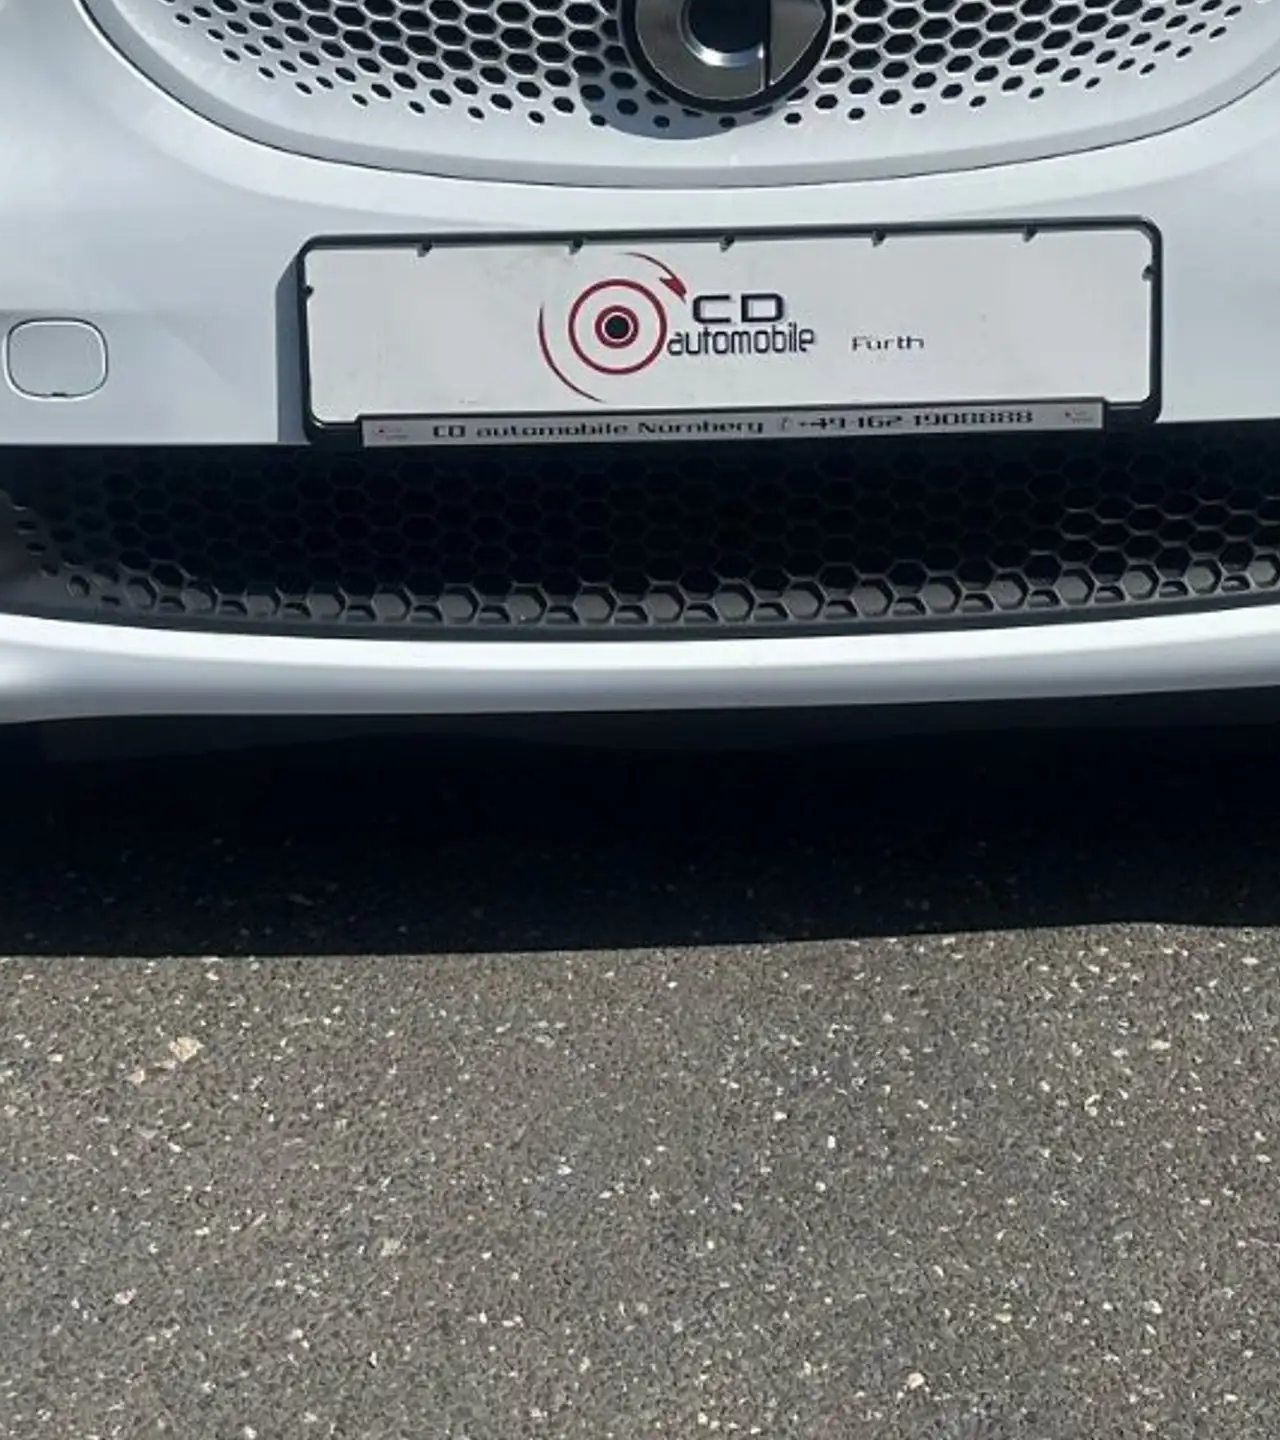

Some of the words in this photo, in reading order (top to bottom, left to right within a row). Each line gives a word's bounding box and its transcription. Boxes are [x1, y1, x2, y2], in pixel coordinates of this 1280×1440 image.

[692, 293, 785, 325] CD
[666, 321, 816, 357] automobile
[433, 424, 466, 438] CD
[476, 421, 628, 438] automobile
